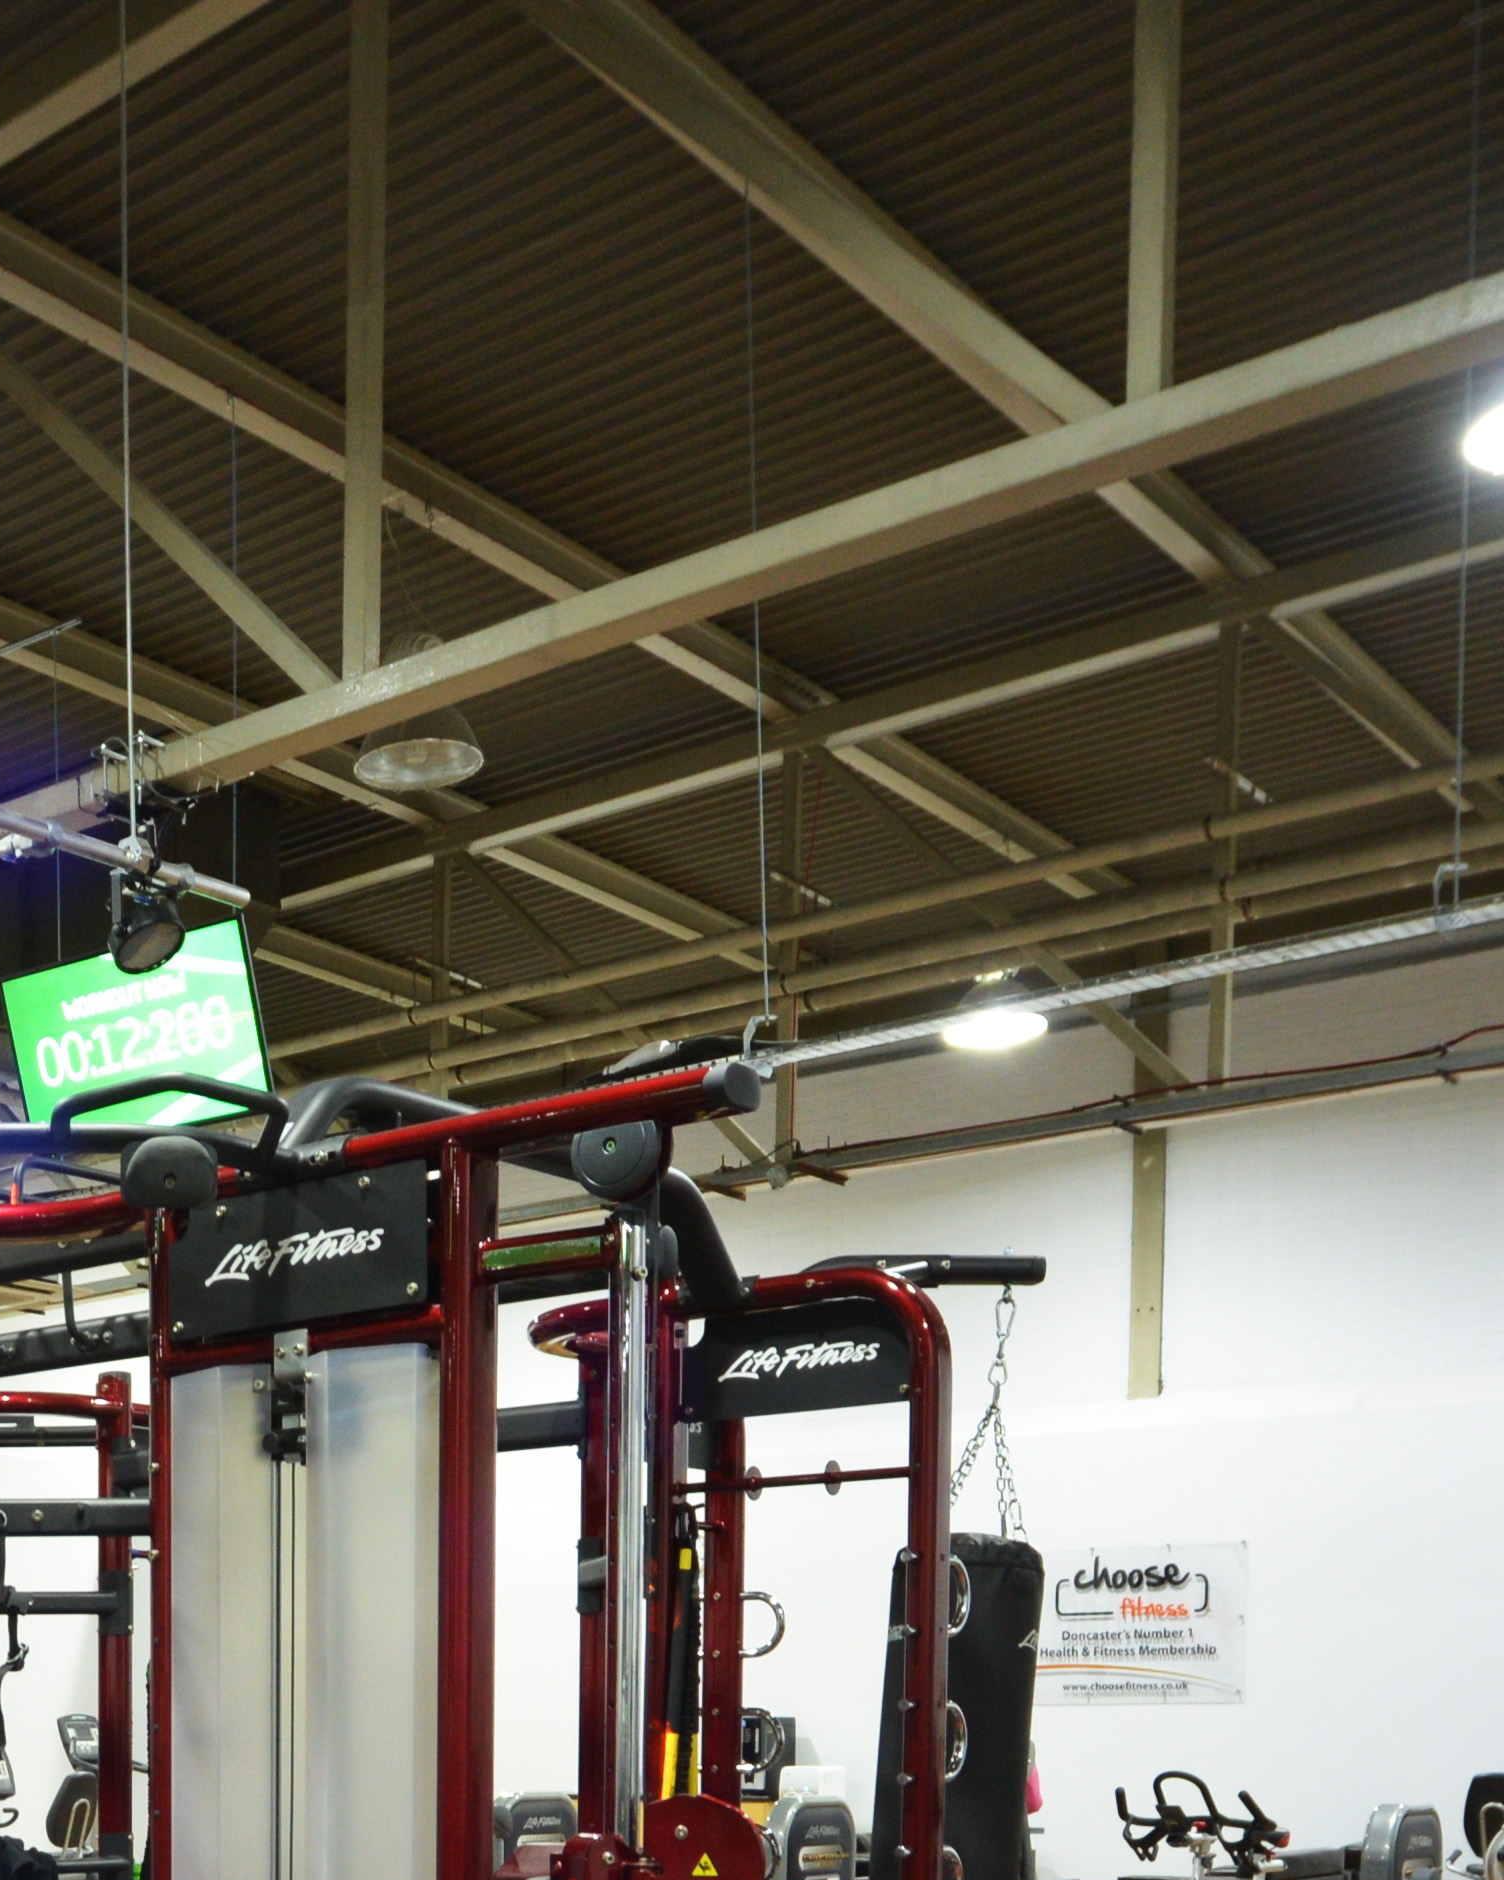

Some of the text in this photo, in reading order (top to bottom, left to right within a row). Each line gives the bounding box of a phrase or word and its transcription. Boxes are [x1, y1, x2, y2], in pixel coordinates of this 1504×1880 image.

[204, 1227, 385, 1287] Life Fitness
[718, 1340, 881, 1383] Life Fitness
[1074, 1557, 1189, 1590] choose
[1120, 1597, 1190, 1618] fitness
[1134, 1629, 1183, 1639] Number
[1188, 1628, 1193, 1637] 1
[1040, 1643, 1217, 1658] Health & Fitness Membership
[1062, 1681, 1189, 1692] www.choosefitness.co.uk
